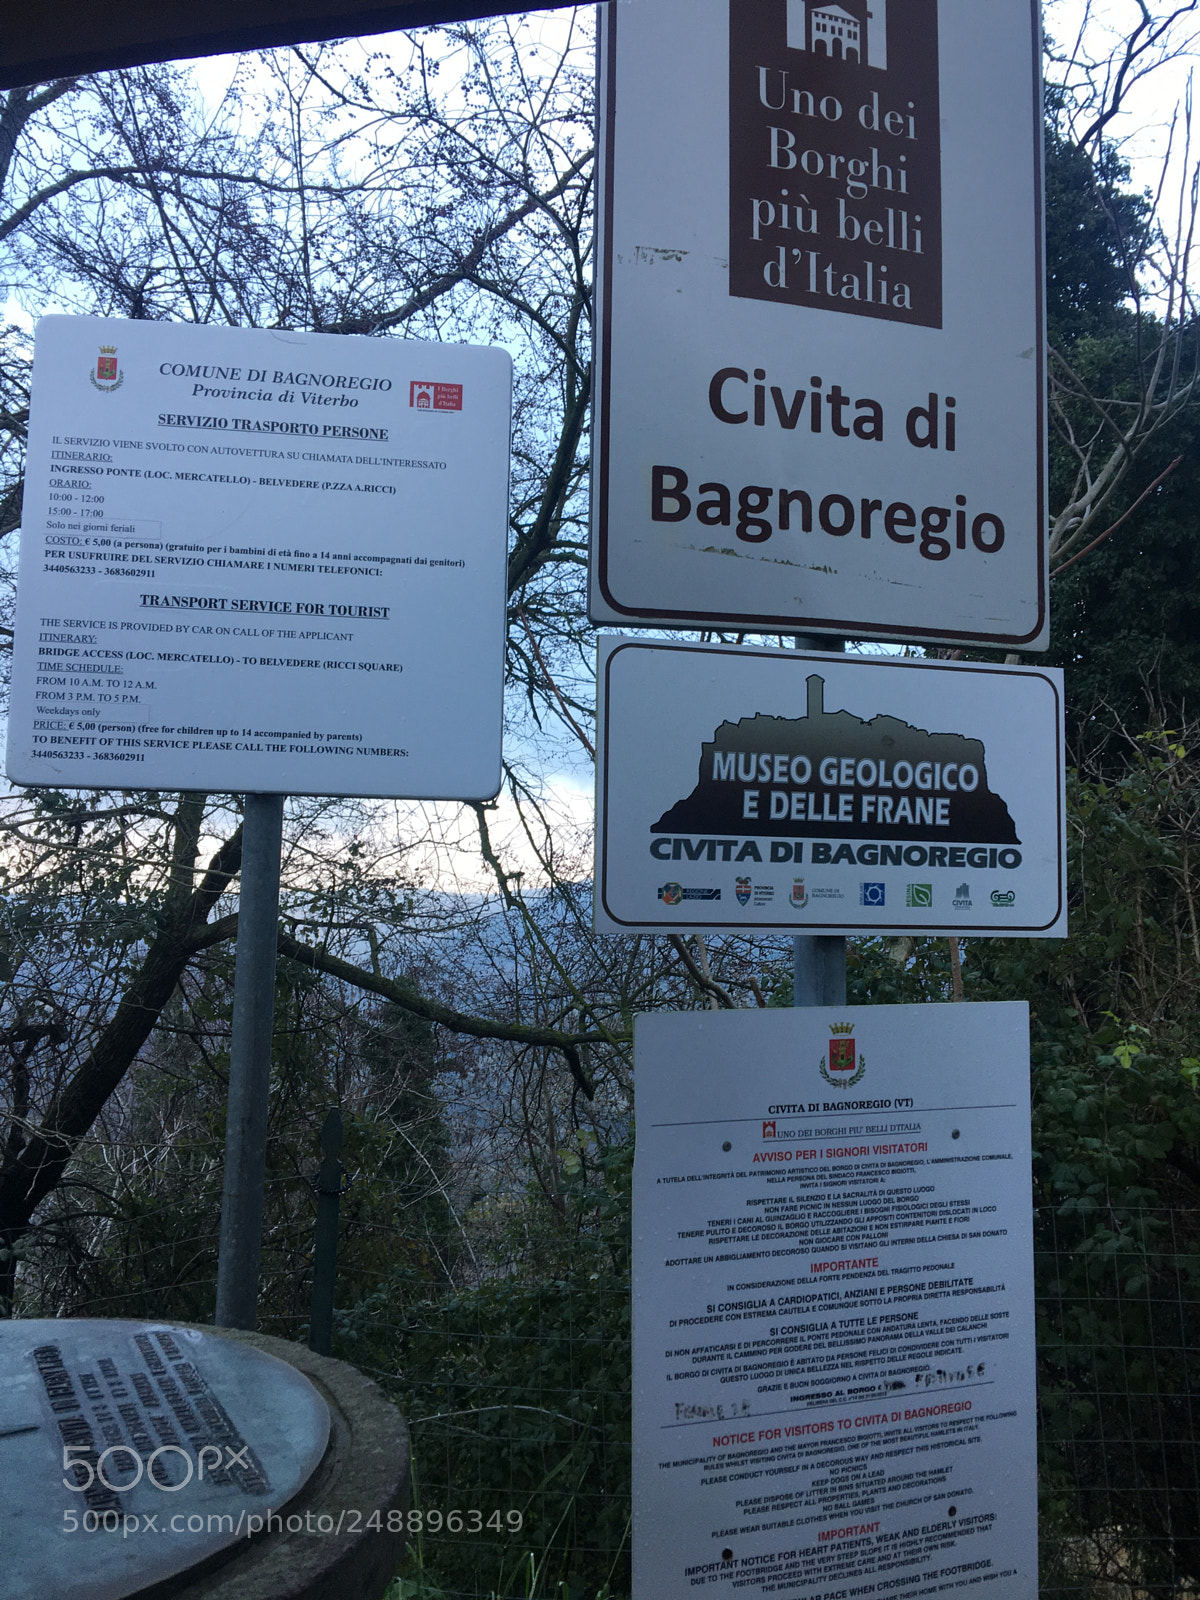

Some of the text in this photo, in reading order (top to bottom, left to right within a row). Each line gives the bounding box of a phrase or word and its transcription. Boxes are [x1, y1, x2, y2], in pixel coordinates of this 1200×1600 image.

[756, 65, 918, 140] Uno dei
[766, 126, 909, 200] Borghi
[750, 190, 923, 255] più belli
[763, 246, 912, 310] d'Italia
[159, 362, 392, 391] COMUNE DI BAGNOREGIO
[192, 383, 358, 407] Provincia di Viterbo
[709, 367, 957, 451] Civita di
[158, 414, 388, 439] SERVIZIO TRASPORTO PERSONE
[51, 450, 112, 462] ITINERARIO:
[52, 436, 446, 469] IL SERVIZIO VIENE SVOLTO CON AUTOVETTURA SU CHIAMATA DELL'INTERESSATO
[49, 478, 91, 489] ORARIO:
[50, 464, 104, 474] INGRESSO
[106, 467, 141, 477] PONTE
[143, 470, 172, 479] (LOC.
[174, 472, 250, 485] MERCATELLO)
[259, 477, 319, 488] BELVEDERE
[321, 482, 352, 491] (P.ZZA
[354, 484, 396, 494] A.RICCI)
[49, 492, 72, 501] 10:00
[81, 494, 104, 503] 12:00
[651, 465, 1005, 562] Bagnoregio
[46, 520, 65, 529] Solo
[82, 524, 108, 532] giorni
[110, 523, 135, 533] feriali
[43, 564, 95, 574] 3440563233
[103, 567, 154, 577] 3683602911
[44, 549, 65, 558] PER
[68, 551, 128, 561] USUFRUIRE
[131, 554, 152, 563] DEL
[154, 556, 204, 565] SERVIZIO
[206, 558, 264, 569] CHIAMARE
[273, 562, 314, 572] NUMERI
[317, 565, 382, 576] TELEFONICI:
[139, 594, 390, 617] TRANSPORT SERVICE FOR TOURIST
[38, 632, 97, 644] ITINERARY:
[37, 661, 123, 674] TIME SCHEDULE:
[36, 676, 156, 689] FROM 10 A.M. TO 12 A.M.
[35, 691, 140, 703] FROM 3 P.M. TO 5 P.M.
[36, 705, 100, 717] Weekdays only
[712, 751, 980, 793] MUSEO GEOLOGICO
[743, 790, 951, 827] E DELLE FRANE
[649, 838, 1023, 869] CIVITA DI BAGNOREGIO
[768, 1098, 913, 1114] CIVITA DI BAGNOREGIO (VT)
[777, 1130, 795, 1138] UNO
[797, 1129, 812, 1137] DEI
[814, 1127, 846, 1136] BORGHI
[865, 1124, 887, 1133] BELLI
[889, 1122, 921, 1131] D'ITALIA
[752, 1142, 927, 1163] AVVISO PER I SIGNORI VISITATORI
[810, 1257, 879, 1273] IMPORTANTE
[706, 1277, 973, 1313] SI CONSIGLIA A CARDIOPATICI, ANZIANI E PERSONE DEBILITATE
[769, 1311, 918, 1336] SI CONSIGLIA A TUTTE LE PERSONE
[712, 1400, 972, 1447] NOTICE FOR VISITORS TO CIVITA DI BAGNOREGIO
[684, 1512, 996, 1576] IMPORTANT NOTICE FOR HEART PATIENTS, WEAK AND ELDERLY VISITORS:
[817, 1521, 880, 1542] IMPORTANT
